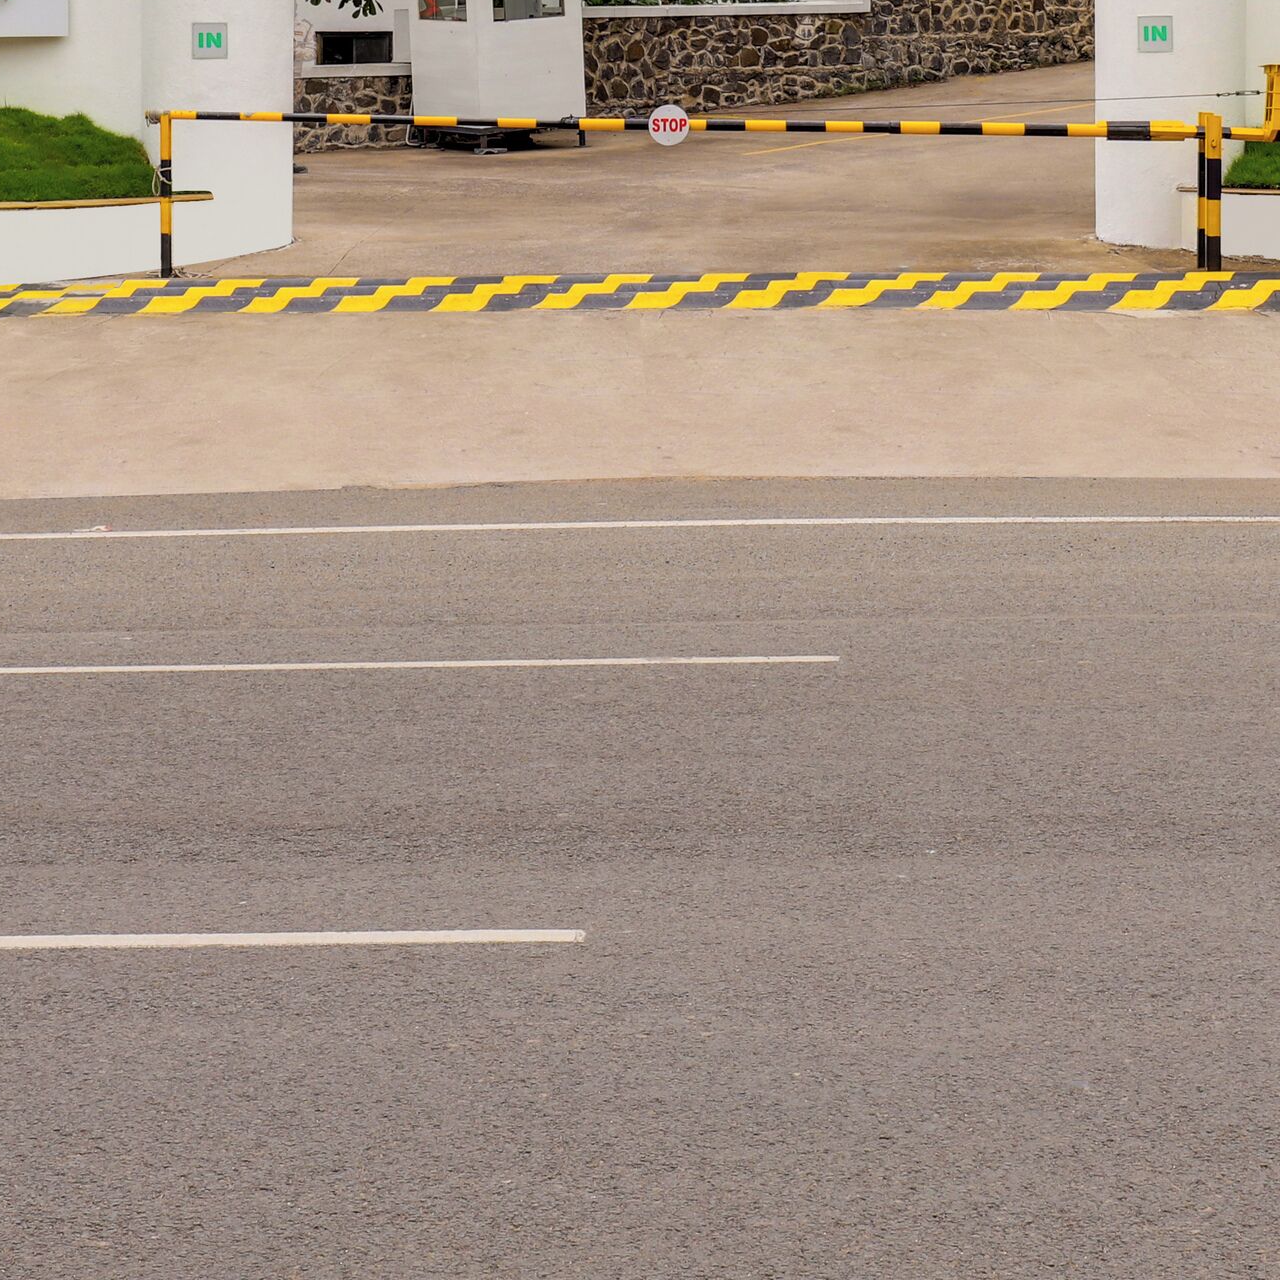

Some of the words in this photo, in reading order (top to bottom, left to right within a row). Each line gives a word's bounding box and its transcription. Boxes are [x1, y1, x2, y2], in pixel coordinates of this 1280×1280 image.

[198, 32, 222, 48] IN
[1143, 25, 1167, 42] IN
[652, 118, 687, 132] STOP
